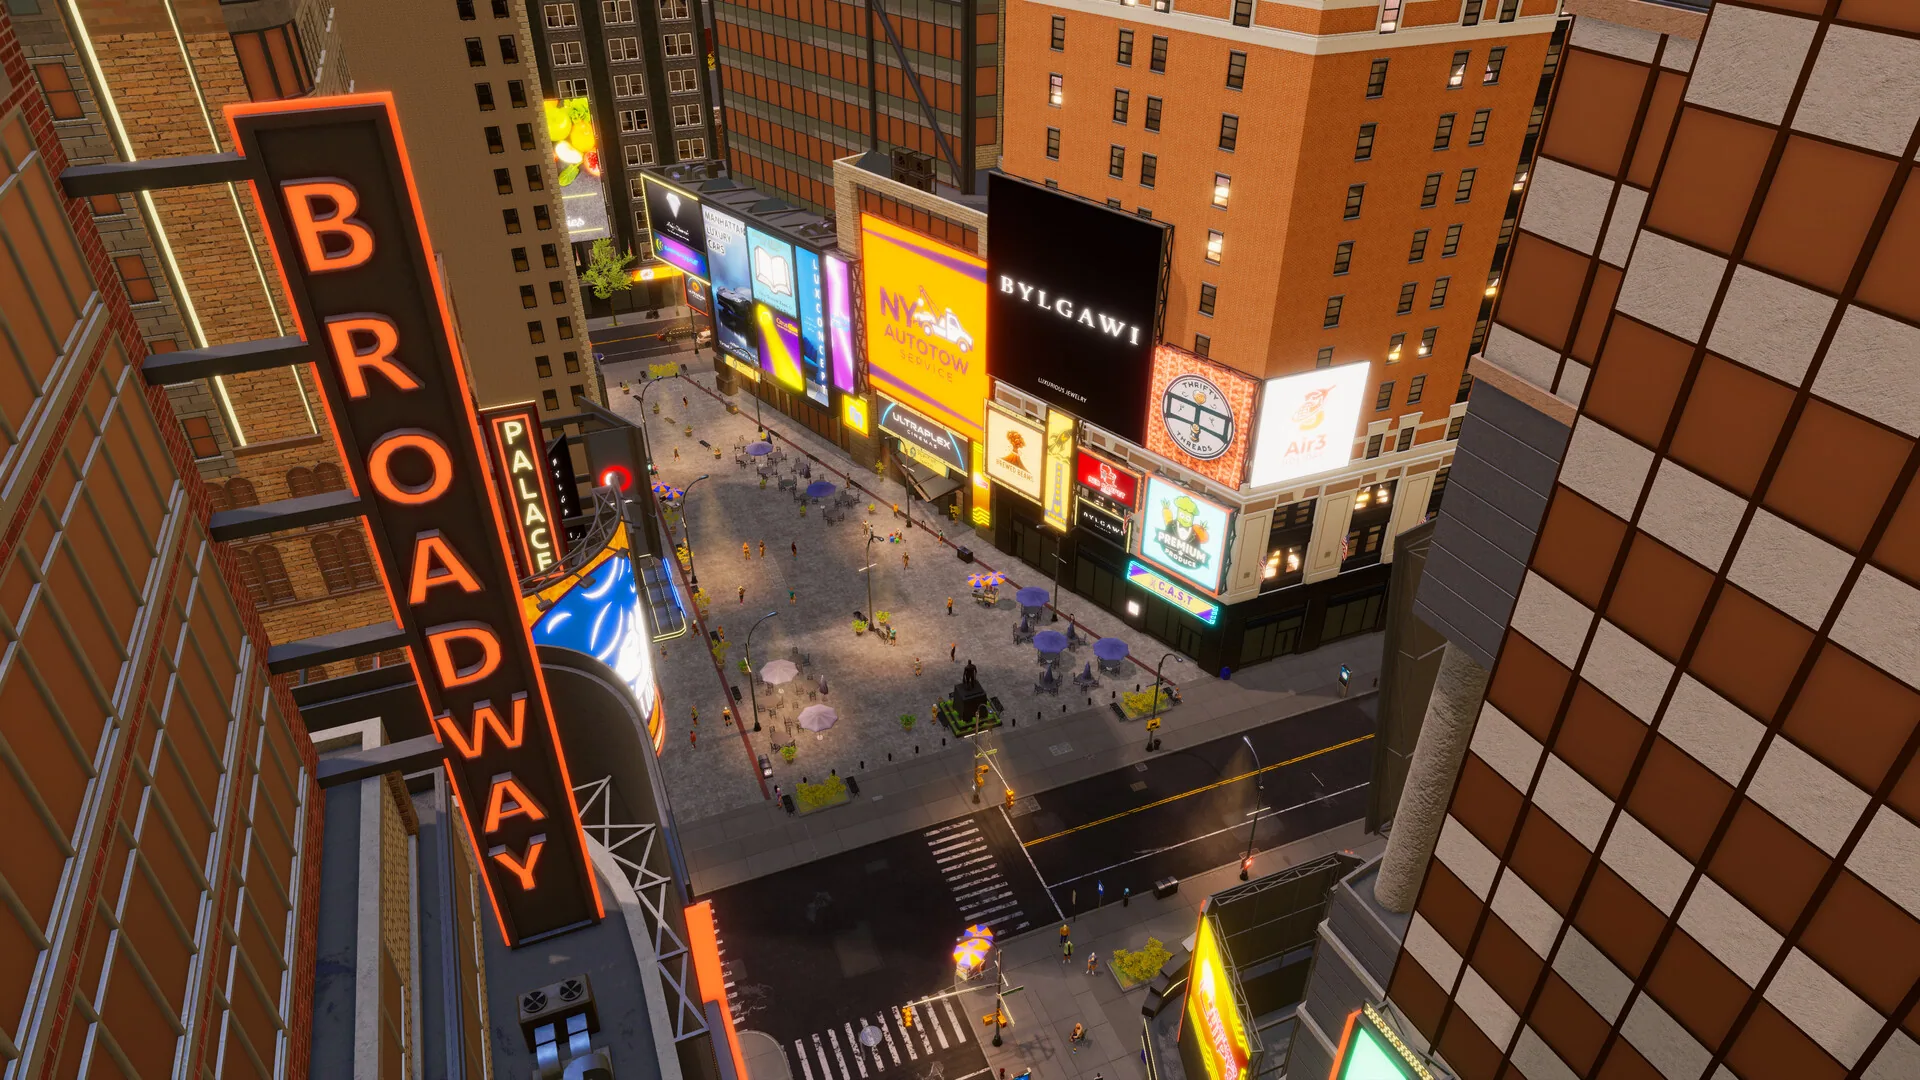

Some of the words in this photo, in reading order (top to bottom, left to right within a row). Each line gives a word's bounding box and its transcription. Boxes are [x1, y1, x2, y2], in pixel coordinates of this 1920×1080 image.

[706, 226, 731, 243] LUXURY
[707, 239, 725, 254] CARS
[879, 285, 918, 328] NY
[1000, 275, 1140, 346] BYLGAWI
[884, 323, 969, 376] AUTOTOW
[900, 349, 953, 384] SERVICE
[1038, 377, 1065, 394] LUXURIOUS
[1065, 388, 1088, 403] JEWELRY
[1181, 382, 1219, 401] THRIFTY
[892, 411, 951, 450] ULTRAPLEX
[907, 429, 938, 449] CINEMAS
[1176, 430, 1213, 453] THREADS
[1284, 433, 1327, 457] Air3
[503, 421, 552, 572] PALACE
[281, 178, 547, 891] BROADWAY
[1157, 531, 1207, 564] PREMIUM
[1164, 548, 1197, 568] PRODUCE
